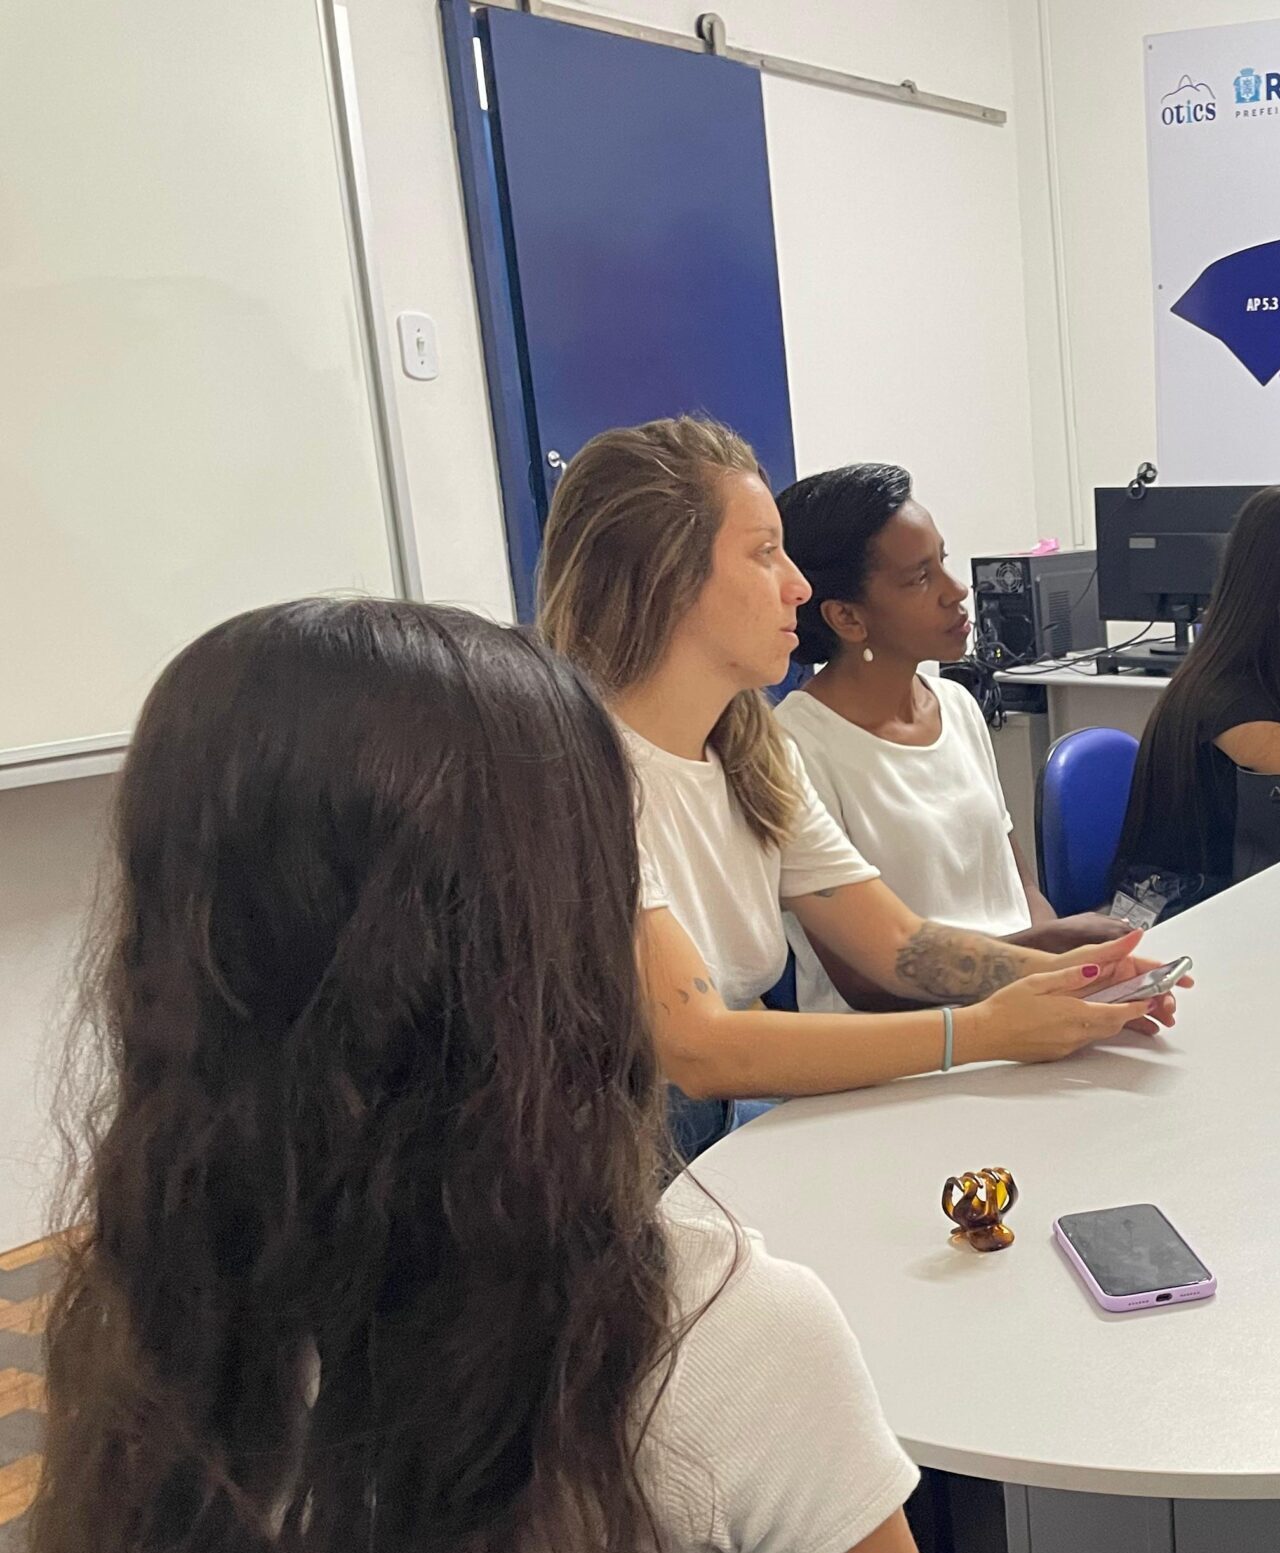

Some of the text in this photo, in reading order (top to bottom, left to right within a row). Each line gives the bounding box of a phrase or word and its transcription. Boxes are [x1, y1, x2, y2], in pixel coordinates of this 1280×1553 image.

[1161, 100, 1216, 126] otics
[1246, 296, 1279, 312] AP 5.3
